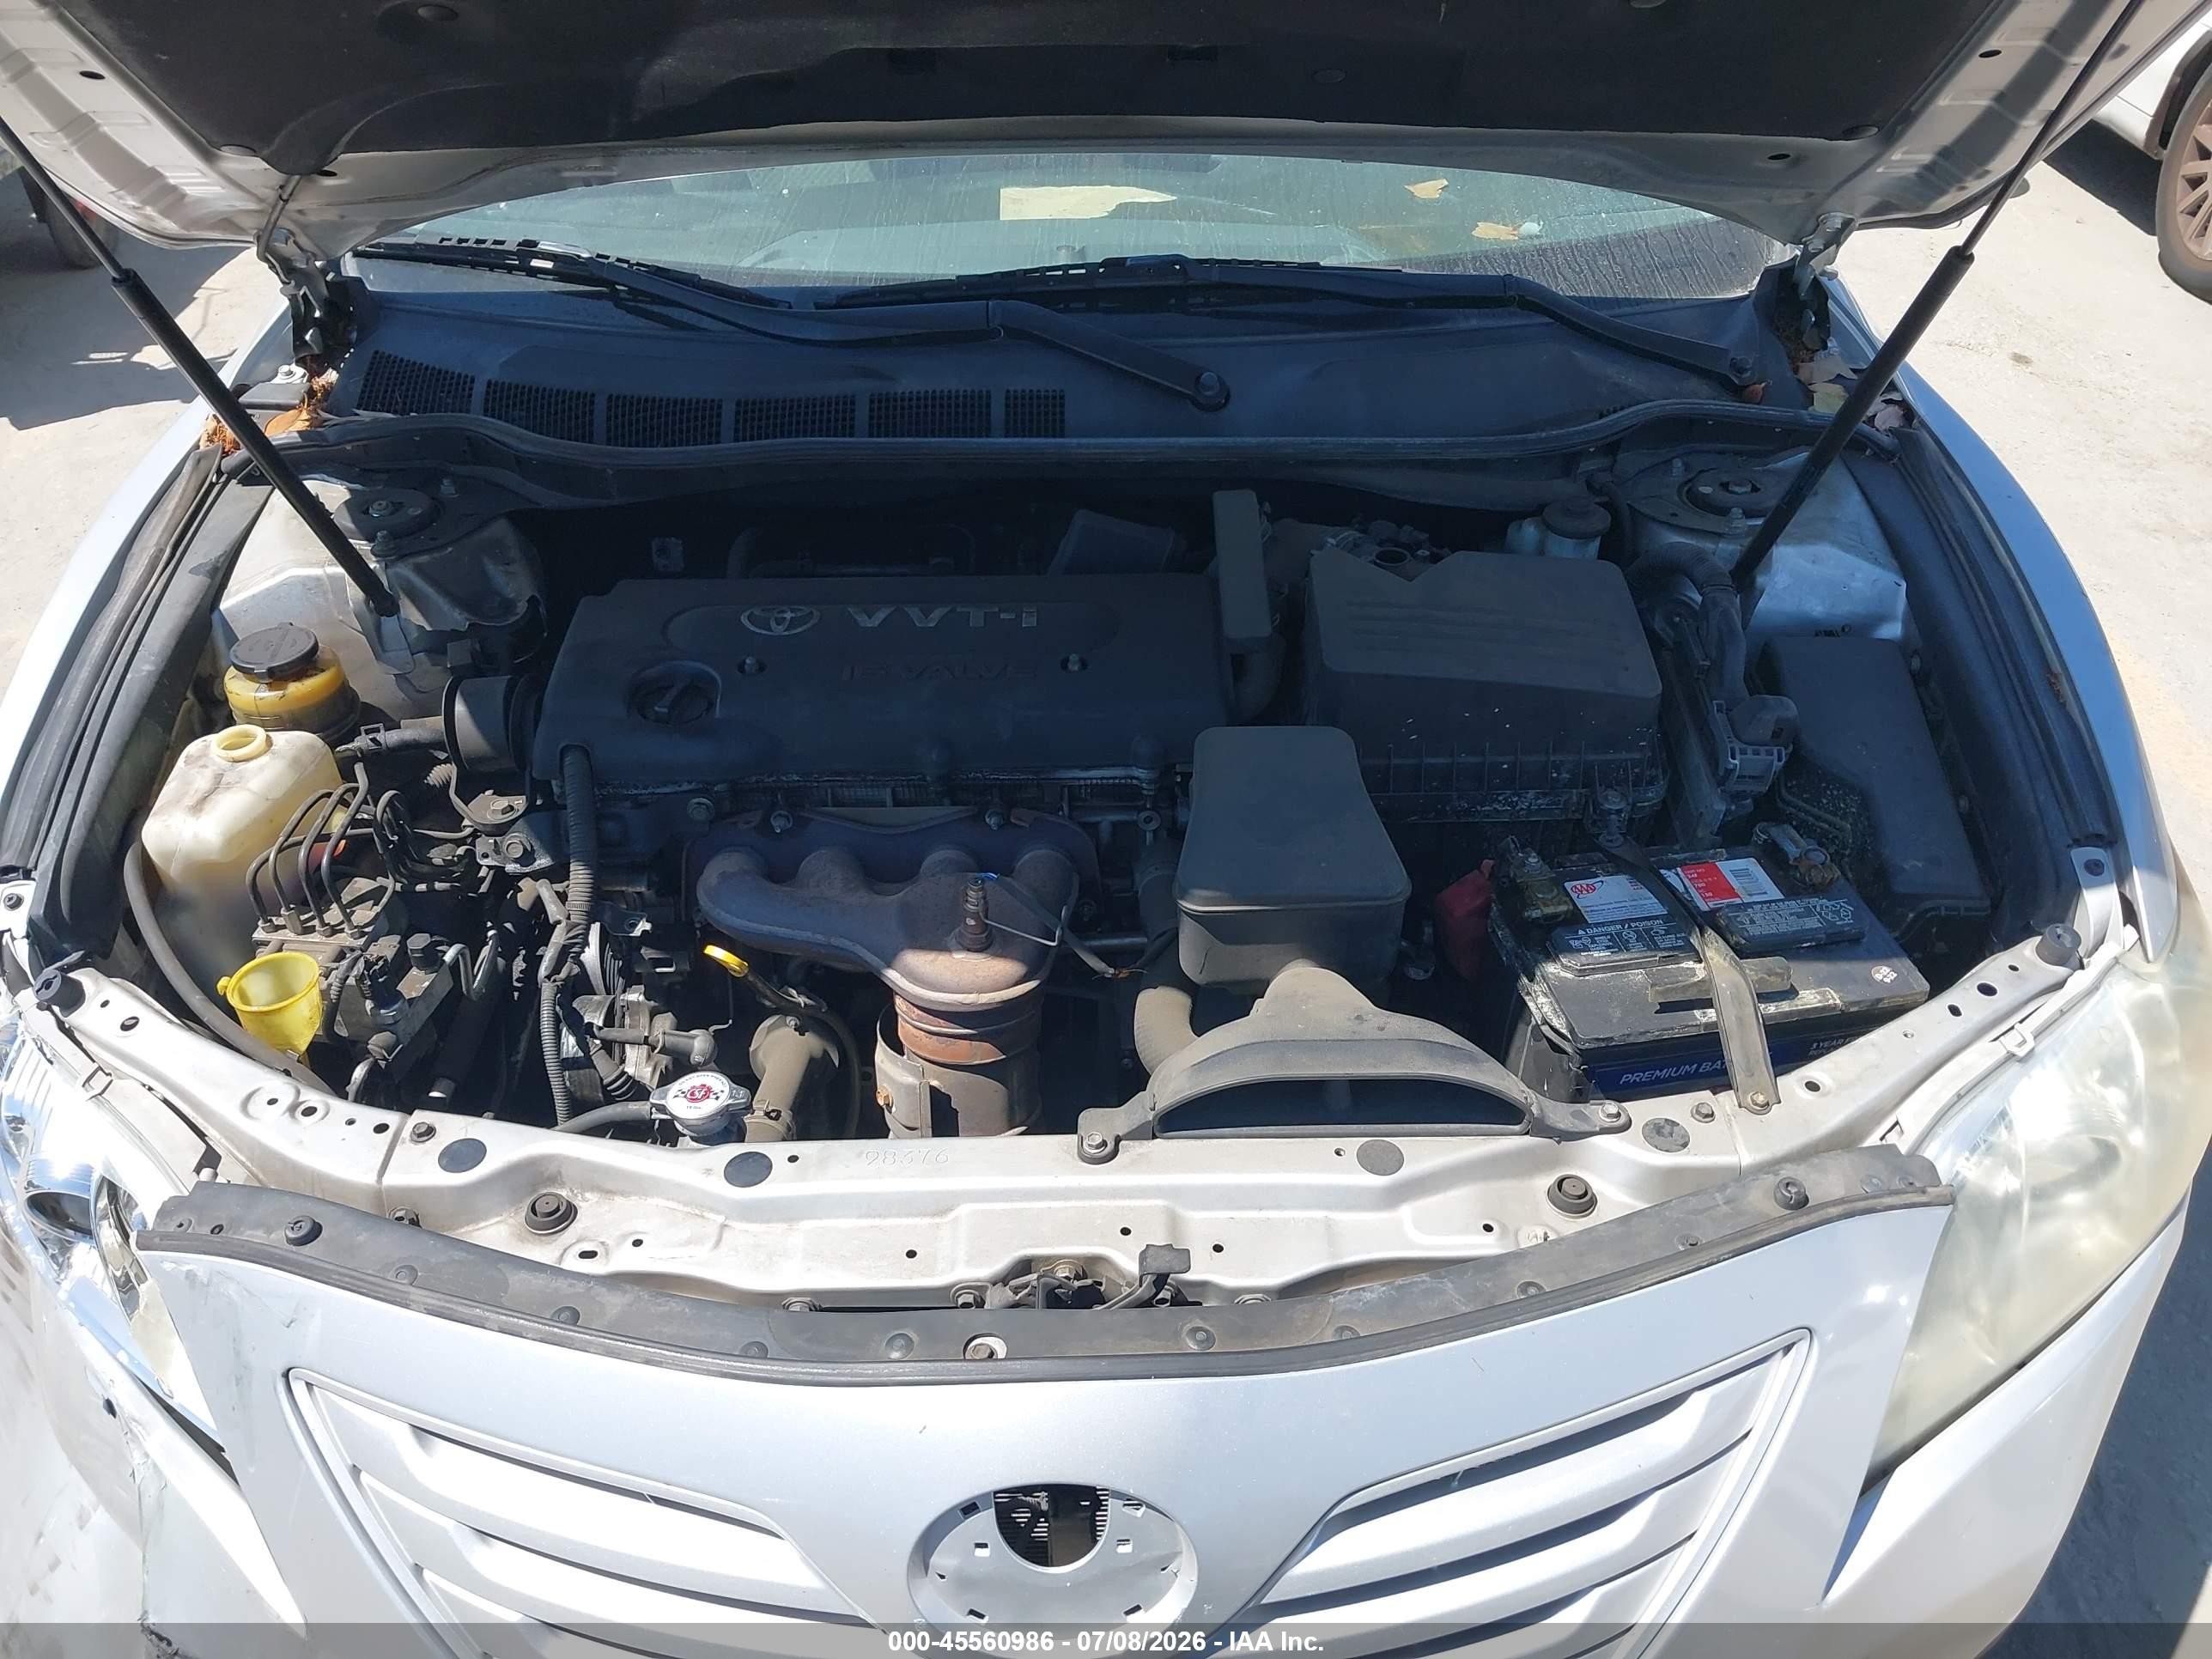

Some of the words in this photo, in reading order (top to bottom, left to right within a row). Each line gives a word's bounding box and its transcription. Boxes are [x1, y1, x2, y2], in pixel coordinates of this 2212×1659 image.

[1572, 884, 1595, 894] AAA
[1586, 924, 1623, 934] DANGER
[1631, 920, 1663, 928] POISON
[1820, 1038, 1844, 1048] YEAR
[1620, 1064, 1698, 1085] PREMIUM
